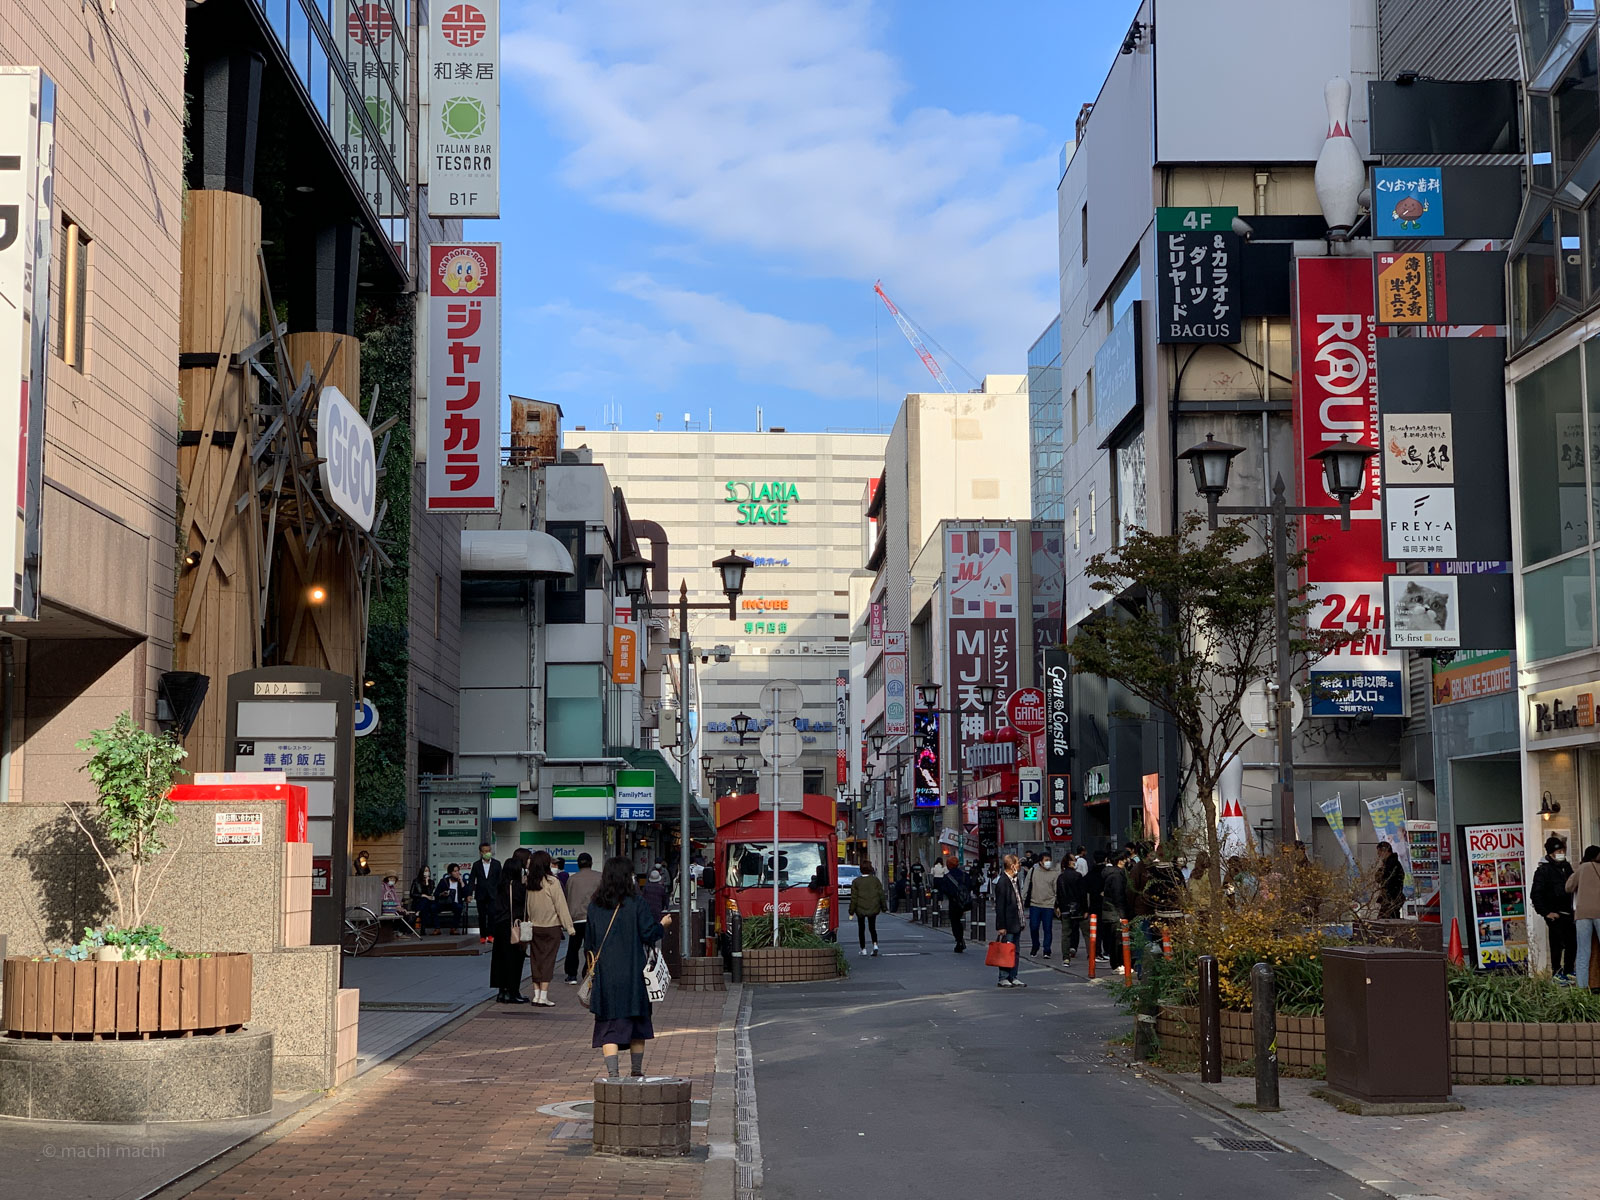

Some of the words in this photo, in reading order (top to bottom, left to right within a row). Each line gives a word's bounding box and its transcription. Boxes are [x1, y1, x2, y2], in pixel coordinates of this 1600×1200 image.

[433, 61, 494, 79] 和楽居
[436, 144, 471, 153] ITALIAN
[474, 144, 491, 153] BAR
[436, 156, 491, 170] TESORO
[1376, 178, 1440, 193] くりおか歯科
[449, 192, 478, 206] B1F
[1182, 210, 1212, 229] 4F
[1168, 234, 1188, 321] ビリヤード
[1189, 246, 1208, 304] ダーツ
[1211, 234, 1230, 321] &カラオケ
[1170, 324, 1230, 337] BAGUS
[1366, 315, 1376, 369] SPORTS
[444, 301, 481, 491] ジャンカラ
[1368, 378, 1381, 496] ENTERTAIMENT
[725, 480, 801, 502] SOLARIA
[736, 503, 790, 525] STAGE
[1390, 522, 1453, 531] FREY-A
[1403, 545, 1443, 553] 福岡天神院
[742, 597, 789, 611] INCUBE
[744, 622, 787, 634] 専門店街
[1395, 633, 1422, 642] P's-first
[620, 644, 629, 667] 郵便局
[993, 628, 1009, 730] パチンコ&スロ
[1047, 665, 1067, 698] Gem
[1451, 673, 1482, 700] BALANCE
[256, 683, 288, 694] DADA
[957, 630, 985, 748] MJ天神
[1015, 706, 1045, 720] GAME
[1052, 711, 1069, 756] Castle
[239, 744, 253, 753] 7F
[263, 753, 326, 766] 華都飯店
[618, 791, 652, 799] FamilyMart
[1021, 780, 1039, 802] P
[620, 808, 630, 818] 酒
[632, 809, 651, 818] たばこ
[1024, 806, 1038, 820] 空
